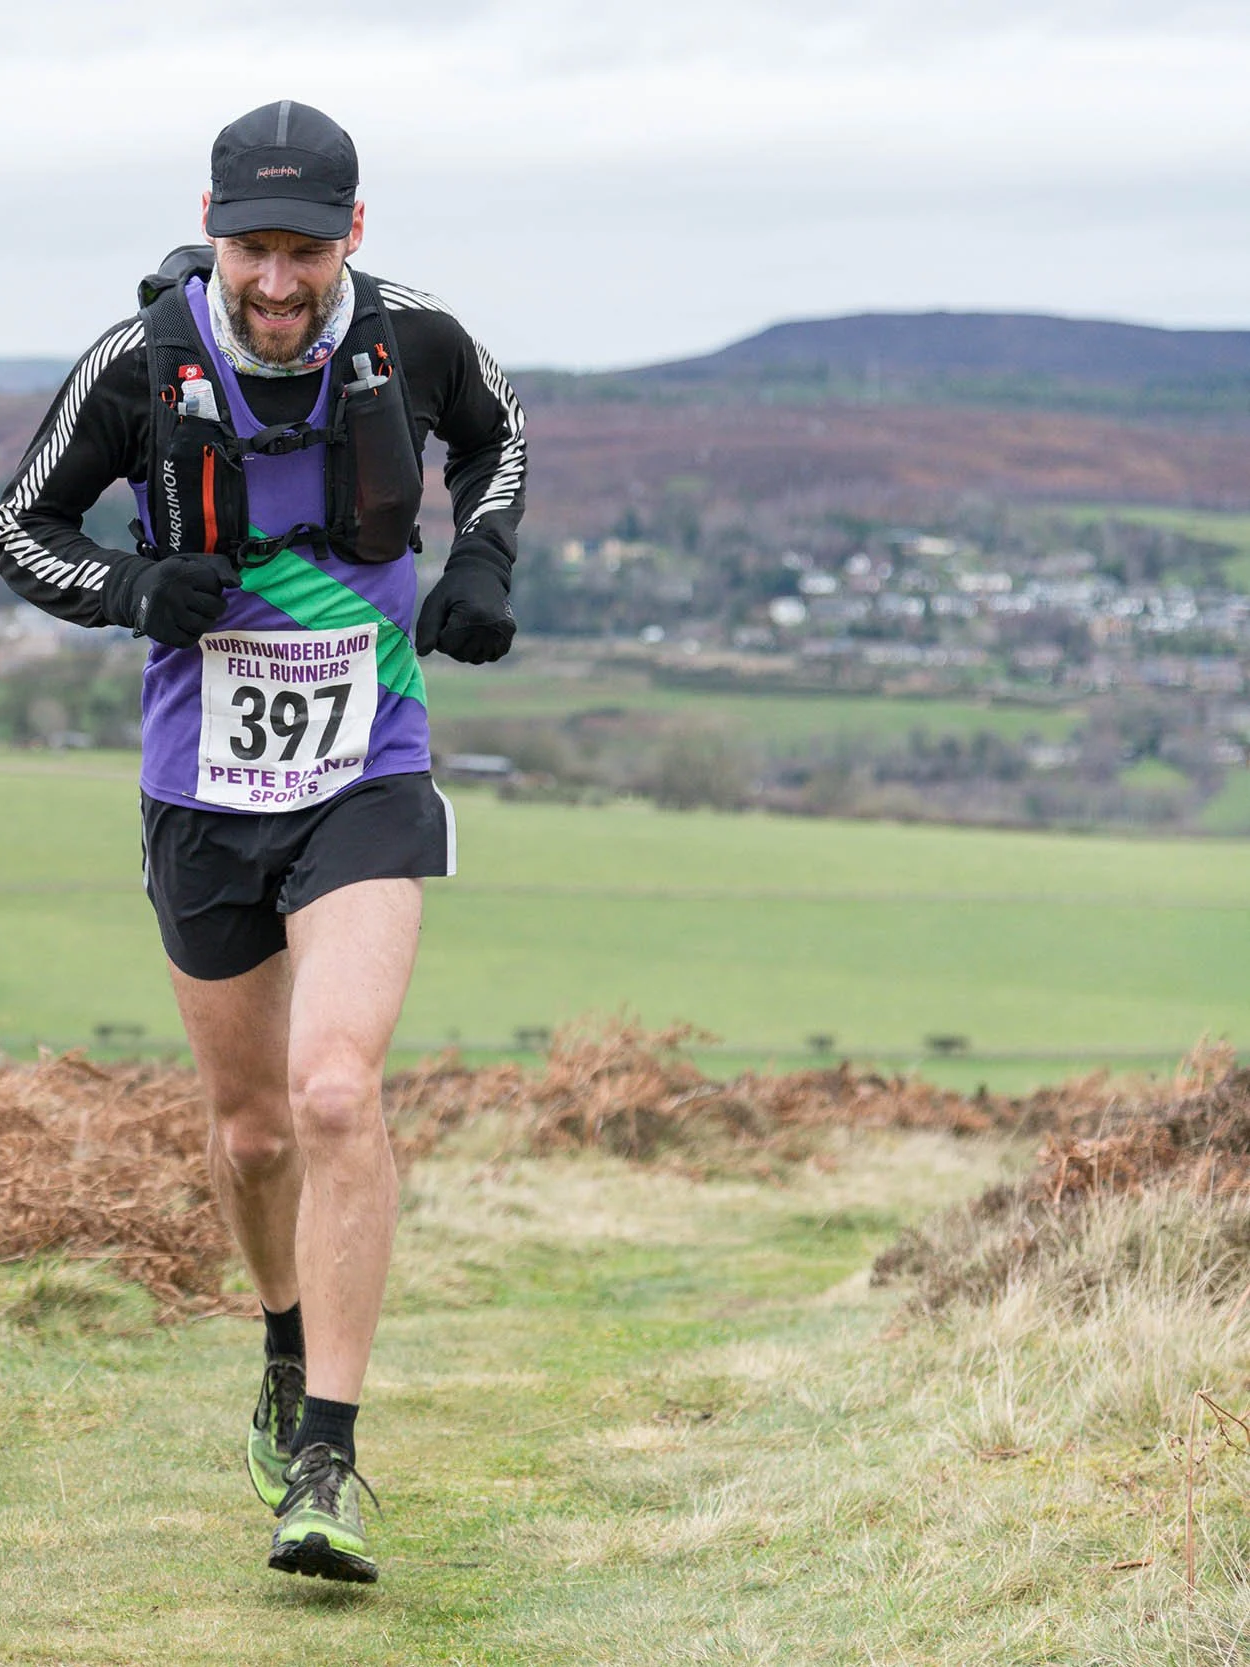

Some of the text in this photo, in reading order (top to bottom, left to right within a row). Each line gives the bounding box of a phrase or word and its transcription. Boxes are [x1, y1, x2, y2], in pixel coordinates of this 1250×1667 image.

[163, 459, 182, 552] KARRIMOR
[205, 634, 369, 661] NORTHUMBERLAND
[228, 657, 350, 683] FELL RUNNERS
[230, 683, 352, 761] 397
[210, 766, 276, 788] PETE
[249, 781, 319, 803] SPORTS
